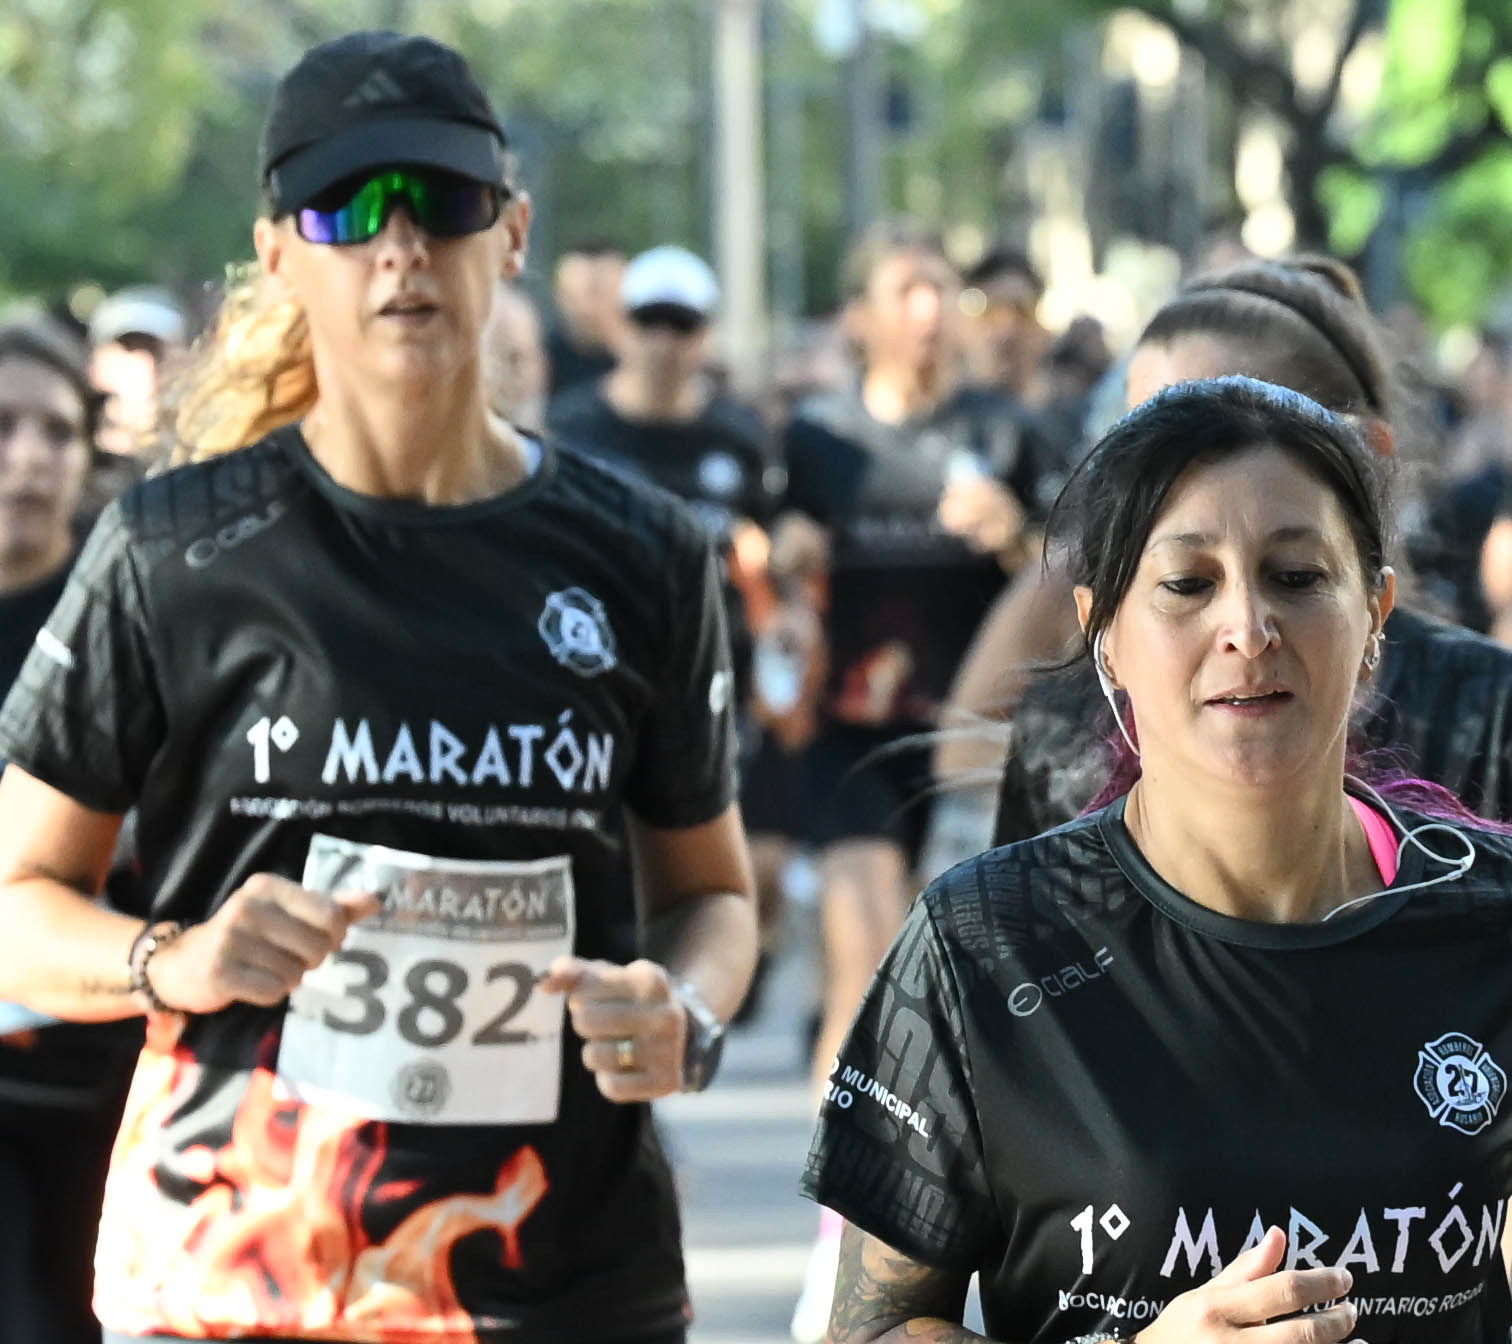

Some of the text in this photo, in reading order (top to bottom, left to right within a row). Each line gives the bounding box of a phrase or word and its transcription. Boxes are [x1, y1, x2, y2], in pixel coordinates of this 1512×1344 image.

[321, 708, 614, 793] MARATÓN
[385, 878, 548, 923] MARATÓN
[321, 949, 539, 1049] 382
[840, 1064, 929, 1138] MUNICIPAL
[1444, 1062, 1479, 1099] 27
[1159, 1182, 1504, 1279] MARATÓN
